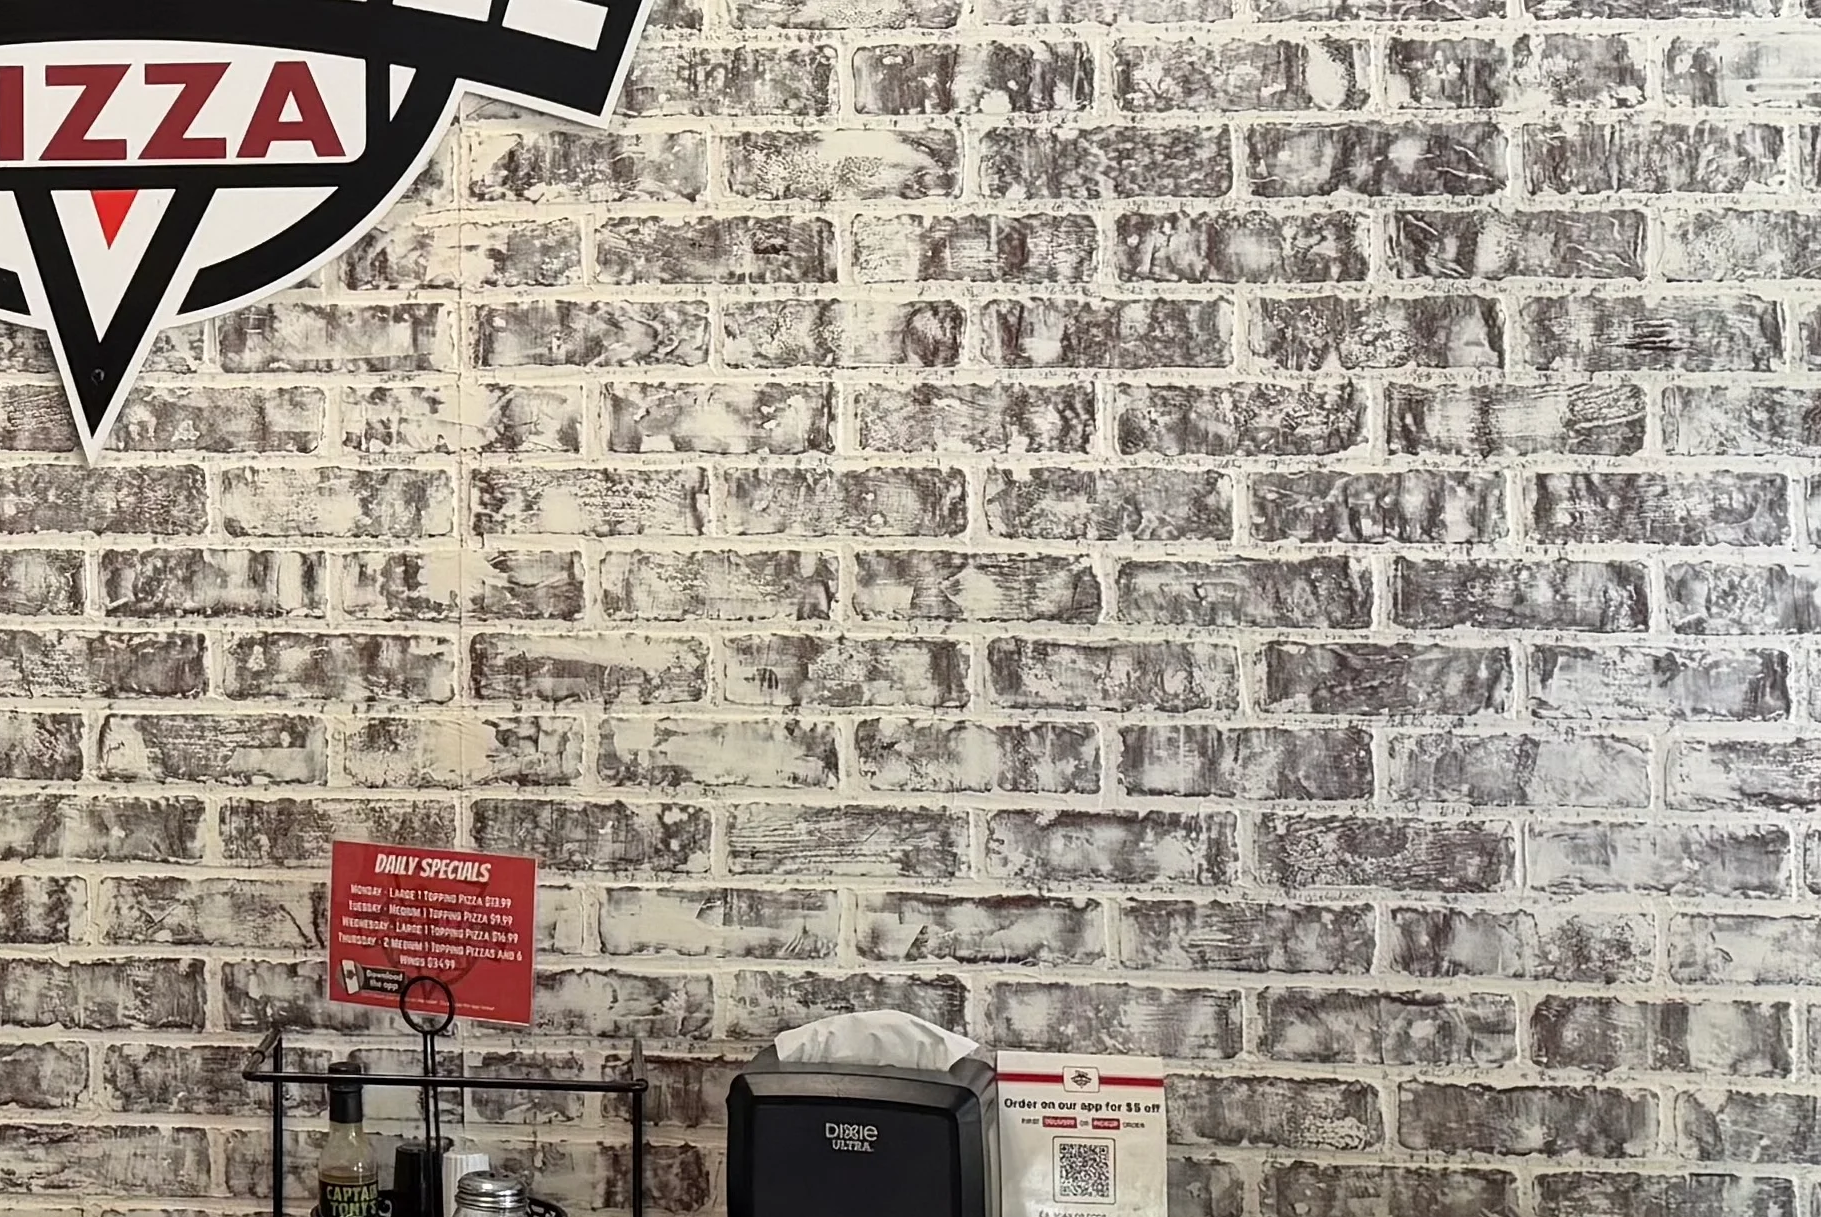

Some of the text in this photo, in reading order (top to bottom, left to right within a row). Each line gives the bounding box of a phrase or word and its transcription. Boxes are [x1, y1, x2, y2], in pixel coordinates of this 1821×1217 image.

[374, 853, 492, 883] DAILY SPECIALS
[458, 894, 483, 906] PIZZA
[463, 911, 488, 924] PIZZA
[465, 928, 490, 941] PIZZA
[383, 937, 389, 948] 2
[465, 945, 495, 959] PIZZAS
[516, 950, 523, 961] 6
[1004, 1097, 1037, 1109] Order
[1040, 1100, 1055, 1110] on
[1058, 1100, 1077, 1111] our
[1080, 1102, 1103, 1113] app
[1105, 1101, 1122, 1112] for
[1144, 1103, 1161, 1113] off
